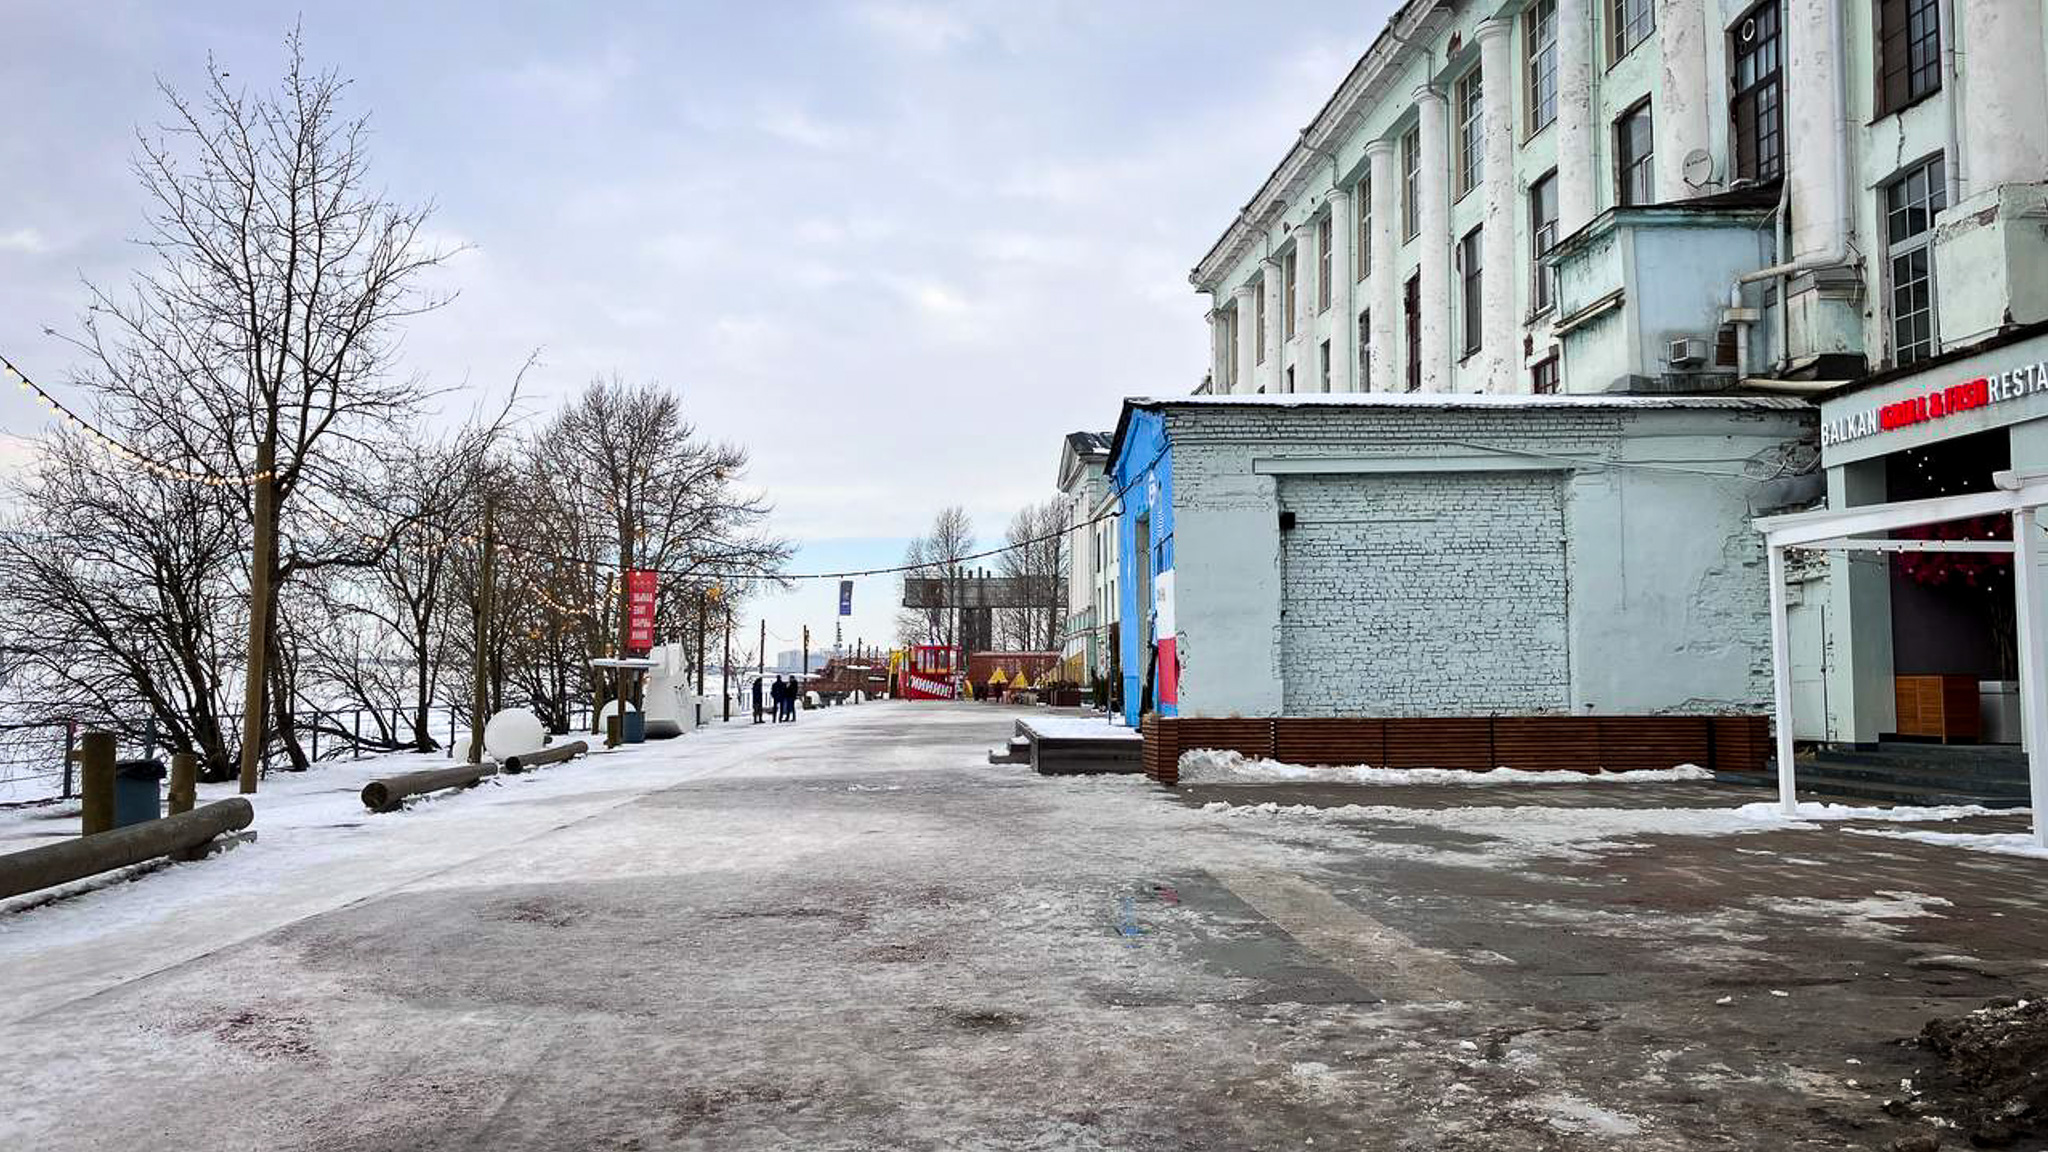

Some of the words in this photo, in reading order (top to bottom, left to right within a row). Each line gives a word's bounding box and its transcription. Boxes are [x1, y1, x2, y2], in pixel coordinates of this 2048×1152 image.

[1821, 409, 1878, 445] BALKAN
[1929, 392, 1945, 418] &
[1988, 361, 2048, 403] RESTA
